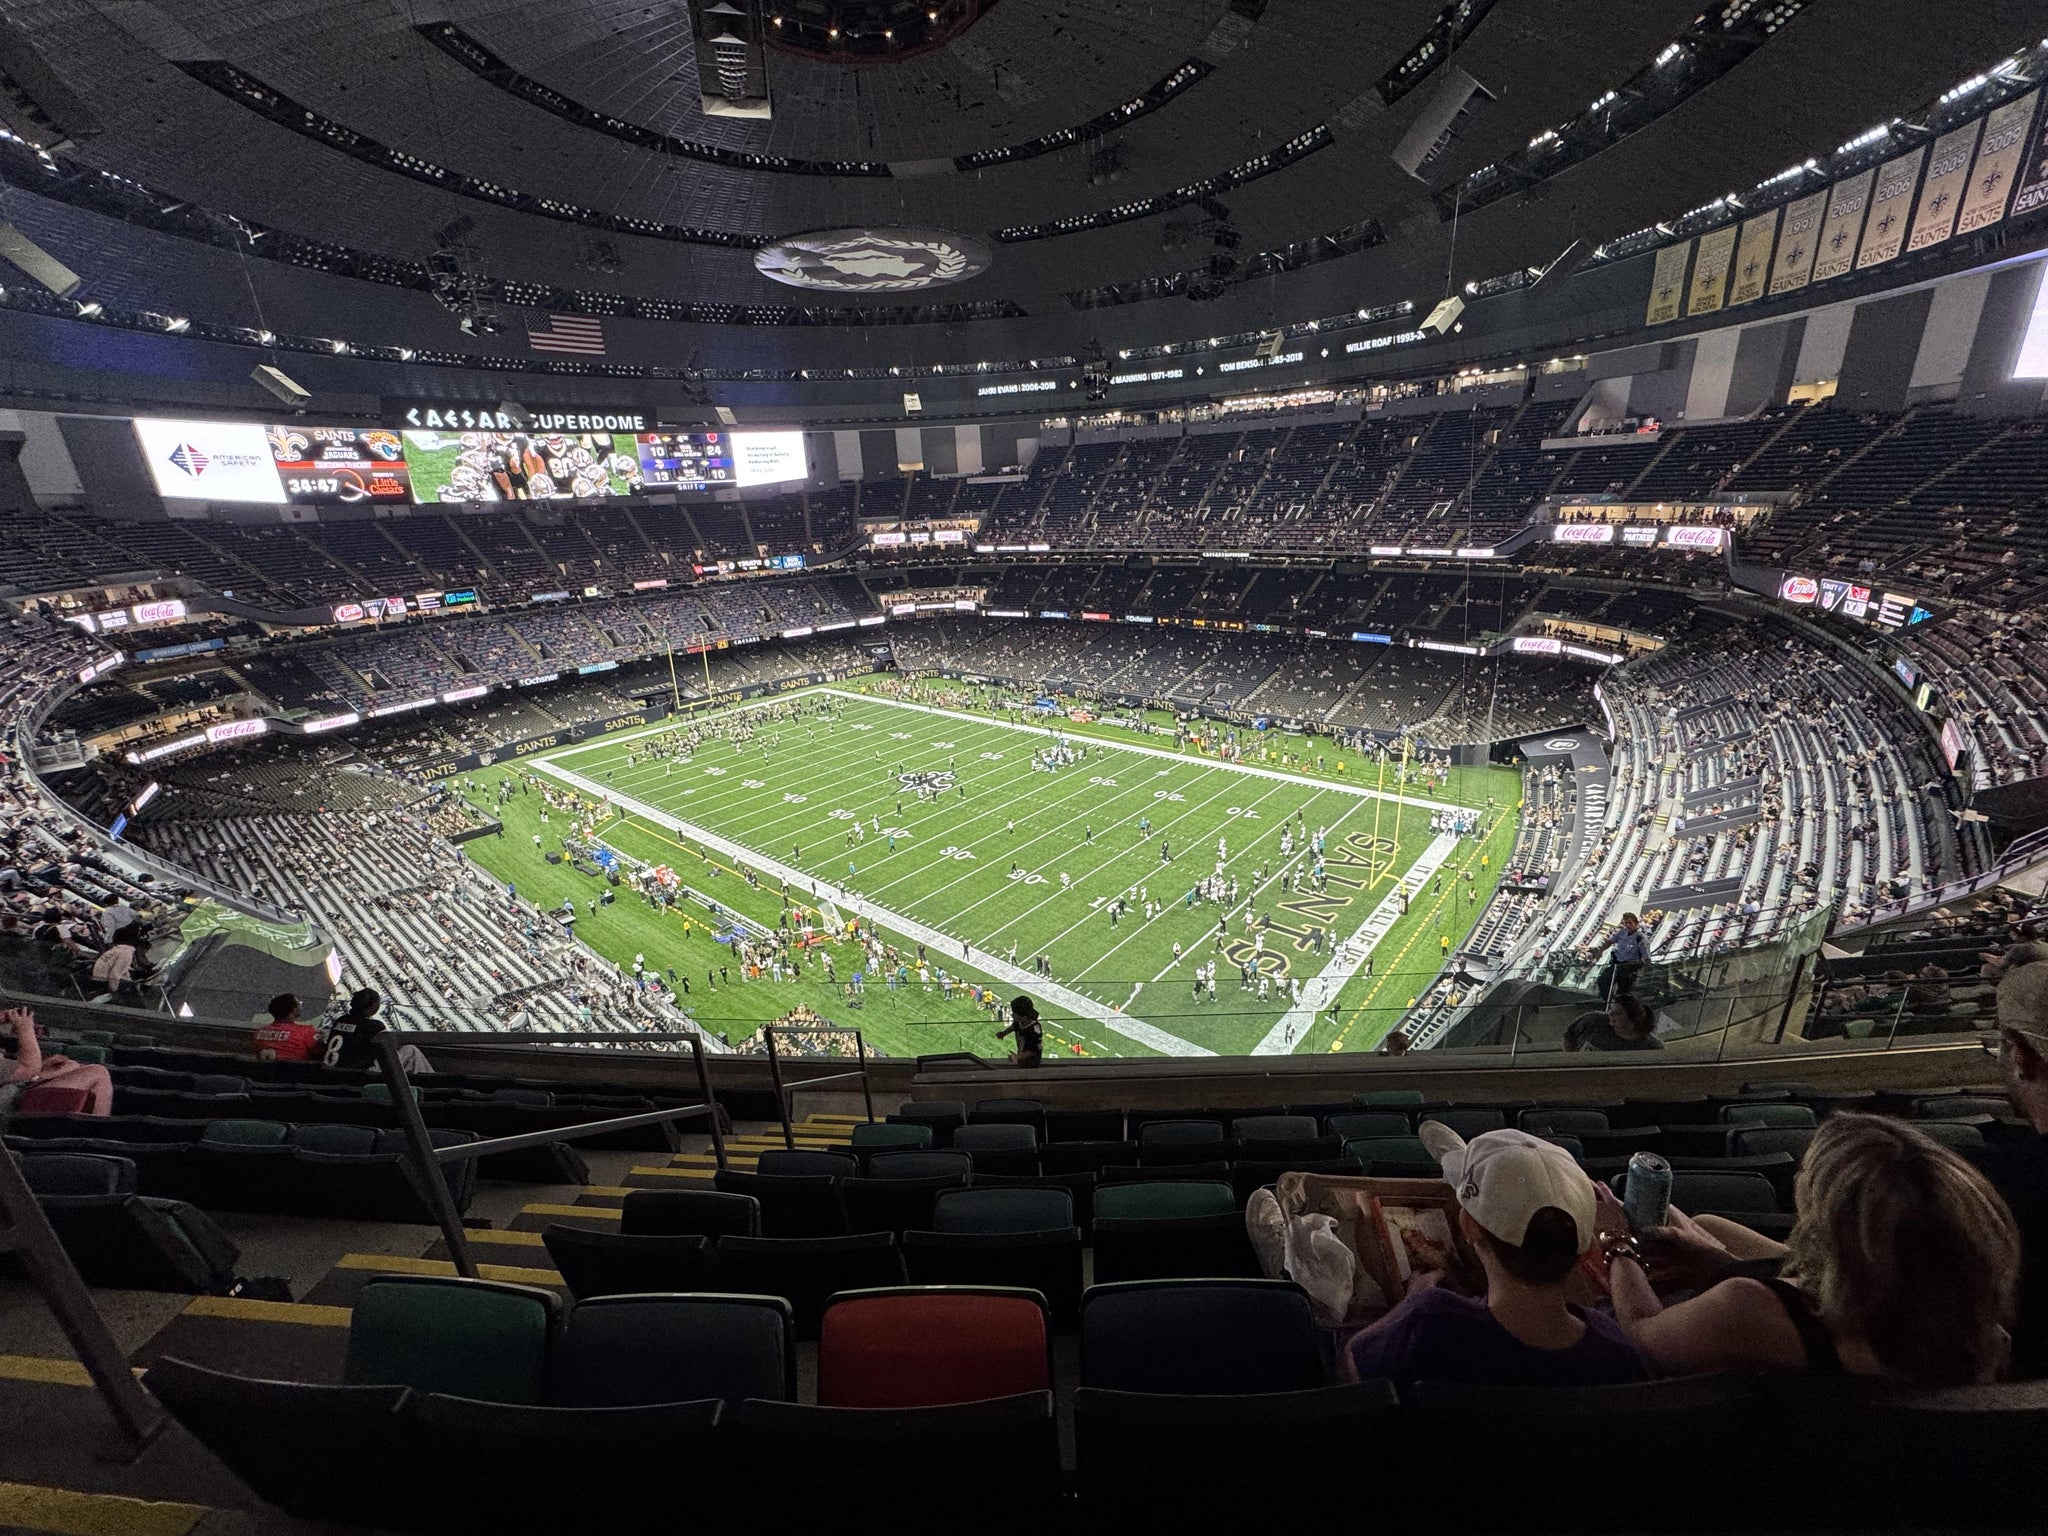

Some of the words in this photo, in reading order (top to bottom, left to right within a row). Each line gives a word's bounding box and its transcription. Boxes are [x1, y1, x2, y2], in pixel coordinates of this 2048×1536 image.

[1983, 125, 2023, 156] 2009
[1931, 151, 1967, 179] 2009
[1878, 176, 1912, 203] 2006
[1830, 197, 1863, 220] 2000
[1787, 216, 1815, 237] 1991
[1961, 208, 2000, 230] SAINTS
[1911, 225, 1949, 248] SAINTS
[1859, 245, 1898, 266] SAINTS
[1814, 260, 1850, 279] SAINTS
[1772, 273, 1808, 293] SAINTS
[1346, 339, 1371, 353] WILLIE
[1371, 336, 1392, 350] ROAF
[1219, 362, 1236, 373] TOM
[1115, 373, 1148, 384] MANNING
[1150, 369, 1184, 381] 1971-1982
[978, 386, 997, 396] JAHRI
[997, 384, 1019, 395] EVANS
[406, 407, 513, 429] CAESAR
[314, 431, 356, 442] SAINTS
[323, 451, 360, 460] JAGUARS
[650, 446, 665, 457] 10
[706, 445, 722, 457] 24
[654, 471, 669, 482] 13
[711, 469, 726, 480] 10
[288, 478, 338, 493] 34:47
[369, 485, 404, 494] Caesars
[373, 478, 399, 487] Little
[847, 664, 874, 677] SAINTS
[524, 673, 558, 686] Ochsner
[780, 678, 810, 691] SAINTS
[629, 682, 673, 695] SAINTS
[1142, 698, 1175, 712] SAINTS
[605, 715, 640, 731] SAINTS
[516, 736, 557, 755] SAINTS
[827, 808, 856, 820] 50
[939, 846, 971, 860] 30
[1413, 864, 1433, 875] IT
[1222, 831, 1402, 977] SAINTS
[1368, 906, 1397, 927] ALL
[1356, 930, 1379, 946] OF
